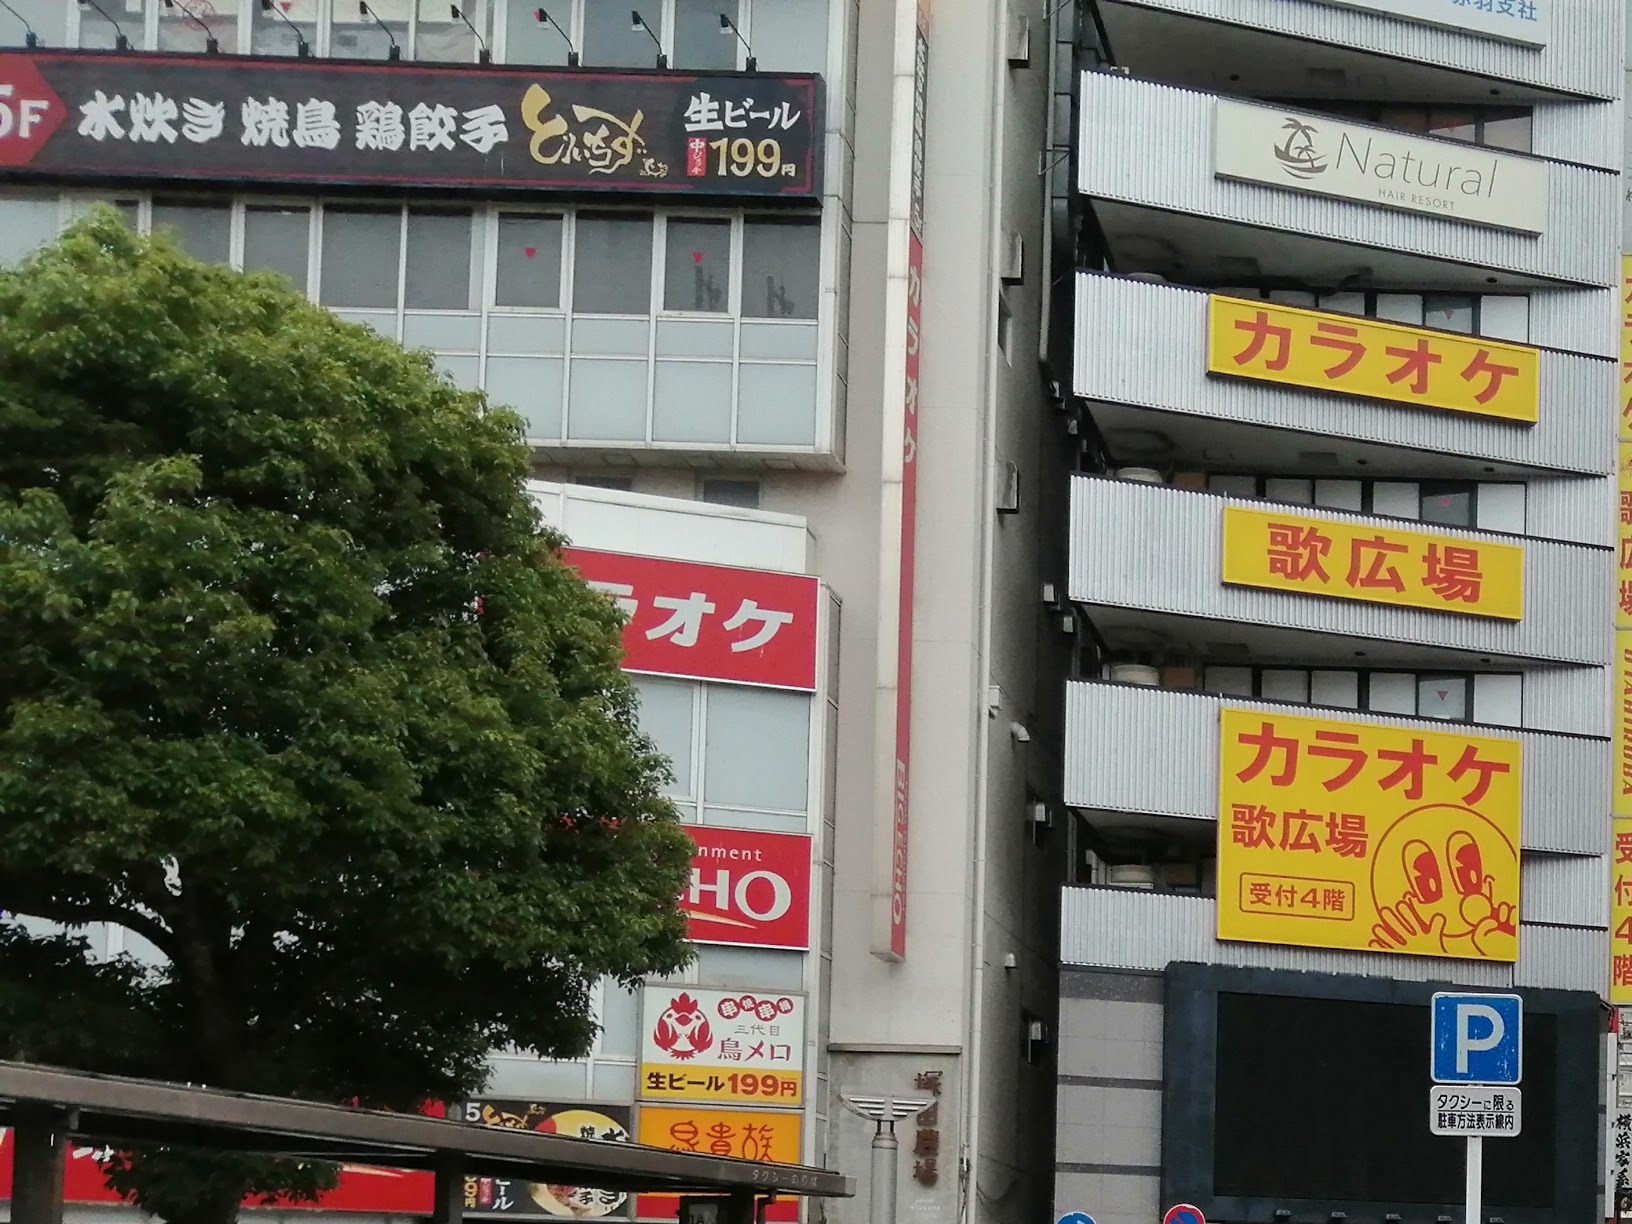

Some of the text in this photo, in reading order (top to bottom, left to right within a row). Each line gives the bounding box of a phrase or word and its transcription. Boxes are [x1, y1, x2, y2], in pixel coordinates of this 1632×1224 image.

[78, 90, 226, 143] 水炊き
[240, 97, 340, 149] 焼鳥
[355, 100, 509, 153] 鶏餃子
[684, 92, 800, 132] 生ビール
[711, 137, 796, 176] 199円
[1335, 130, 1497, 198] Natural
[1411, 194, 1456, 211] RESORT
[1232, 310, 1520, 404] カラオケ
[1266, 523, 1484, 603] 歌広場
[589, 580, 793, 652] ラオケ
[1235, 722, 1510, 805] カラオケ
[1231, 803, 1369, 859] 歌広場
[696, 844, 763, 863] nment
[676, 868, 792, 922] HO
[1249, 881, 1347, 914] 受付4階
[718, 1038, 791, 1061] 鳥メロ
[734, 1024, 780, 1036] 三代目
[1456, 1004, 1504, 1073] P
[647, 1072, 797, 1097] 生ビール 199円
[1438, 1094, 1514, 1110] タクシーに限る
[670, 1121, 774, 1161] 鳥貴族
[1438, 1113, 1514, 1130] 駐車方法表示線内
